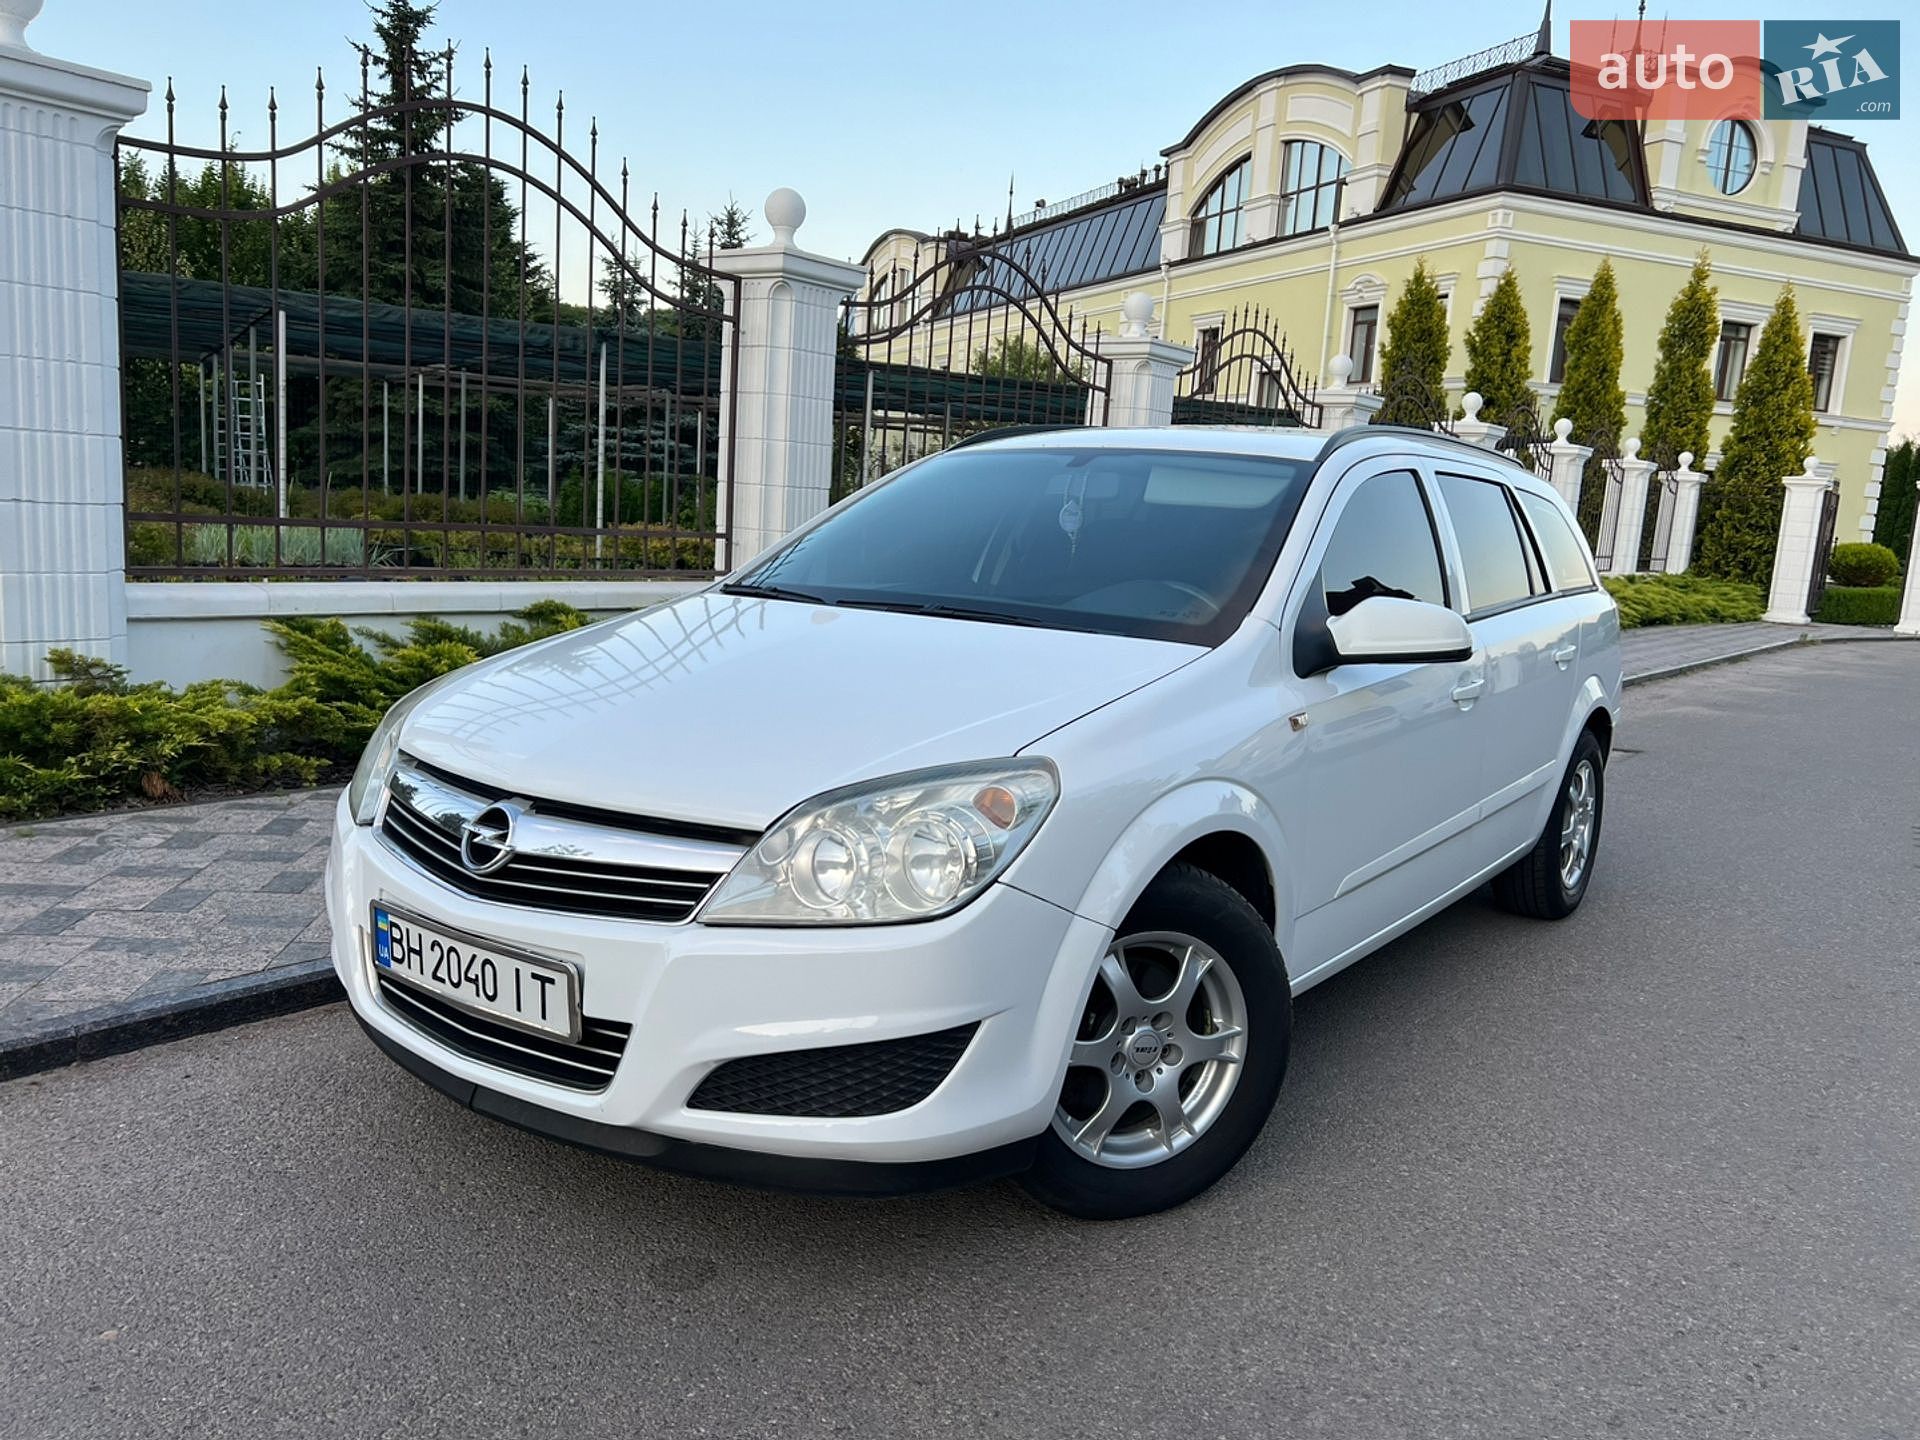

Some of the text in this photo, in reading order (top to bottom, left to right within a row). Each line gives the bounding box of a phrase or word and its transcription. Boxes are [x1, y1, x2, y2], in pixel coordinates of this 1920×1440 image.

[378, 943, 389, 959] UA
[389, 921, 555, 1020] BH 2040 IT
